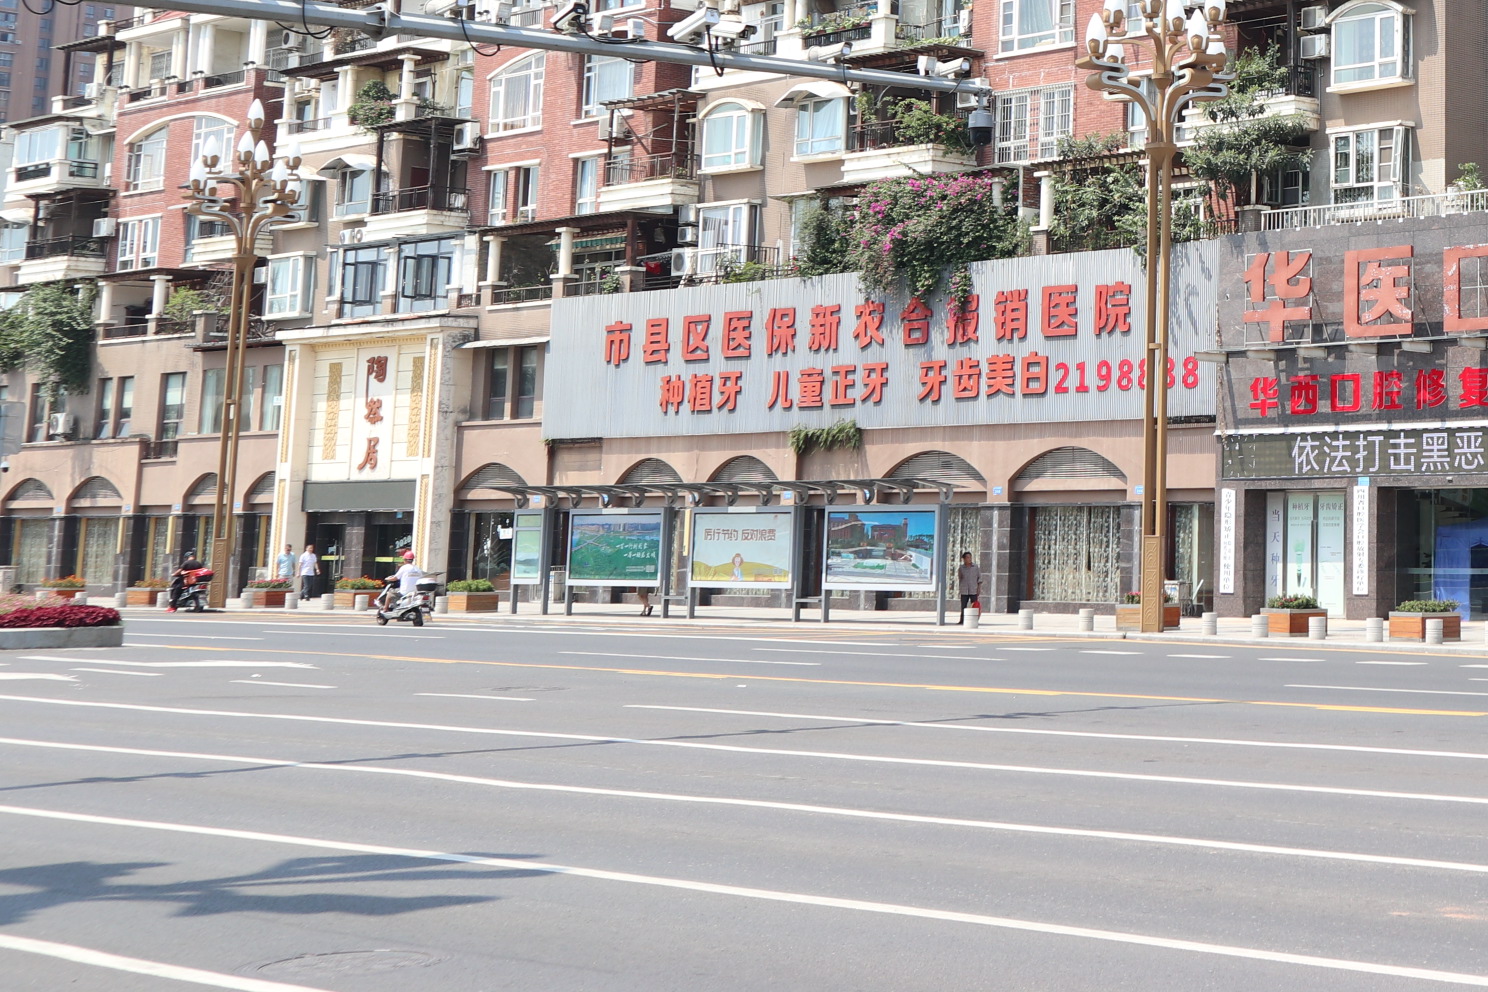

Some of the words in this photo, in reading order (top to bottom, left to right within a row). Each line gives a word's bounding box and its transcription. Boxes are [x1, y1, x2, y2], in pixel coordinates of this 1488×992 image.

[604, 281, 1131, 365] 市县区医保新农合报销医院
[659, 371, 742, 412] 种植牙
[768, 362, 888, 408] 儿童正牙
[704, 528, 738, 541] 厉行节约
[741, 528, 777, 541] 反对浪费
[1270, 509, 1280, 588] 当天种牙
